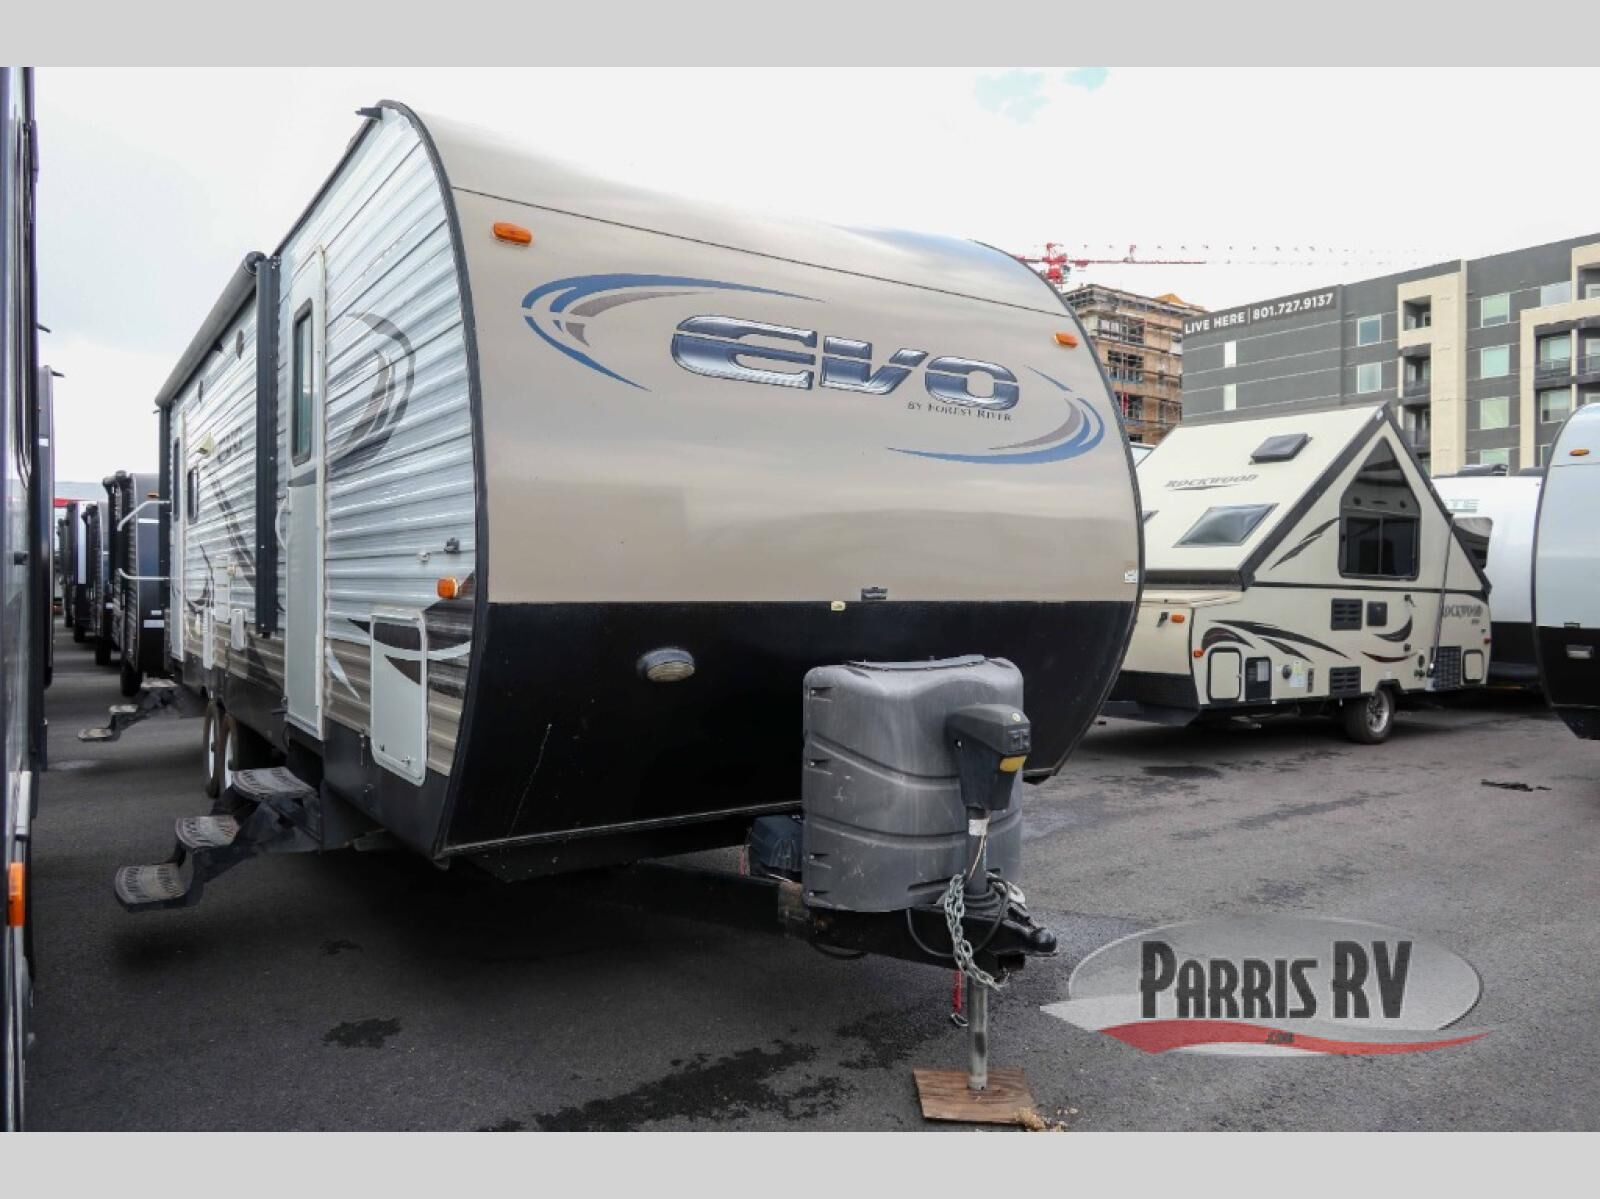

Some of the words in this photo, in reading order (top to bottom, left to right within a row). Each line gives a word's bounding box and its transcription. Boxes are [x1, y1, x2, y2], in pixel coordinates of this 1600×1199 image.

[1184, 319, 1210, 335] LIVE
[1213, 311, 1246, 329] HERE
[1252, 292, 1334, 320] 801.727.9137
[670, 314, 1020, 411] EVO
[907, 400, 921, 410] BY
[928, 403, 971, 417] FOREST
[977, 409, 1012, 421] RIVER
[1165, 473, 1258, 488] ROCKWOOD
[1441, 604, 1483, 618] OCKWOOD
